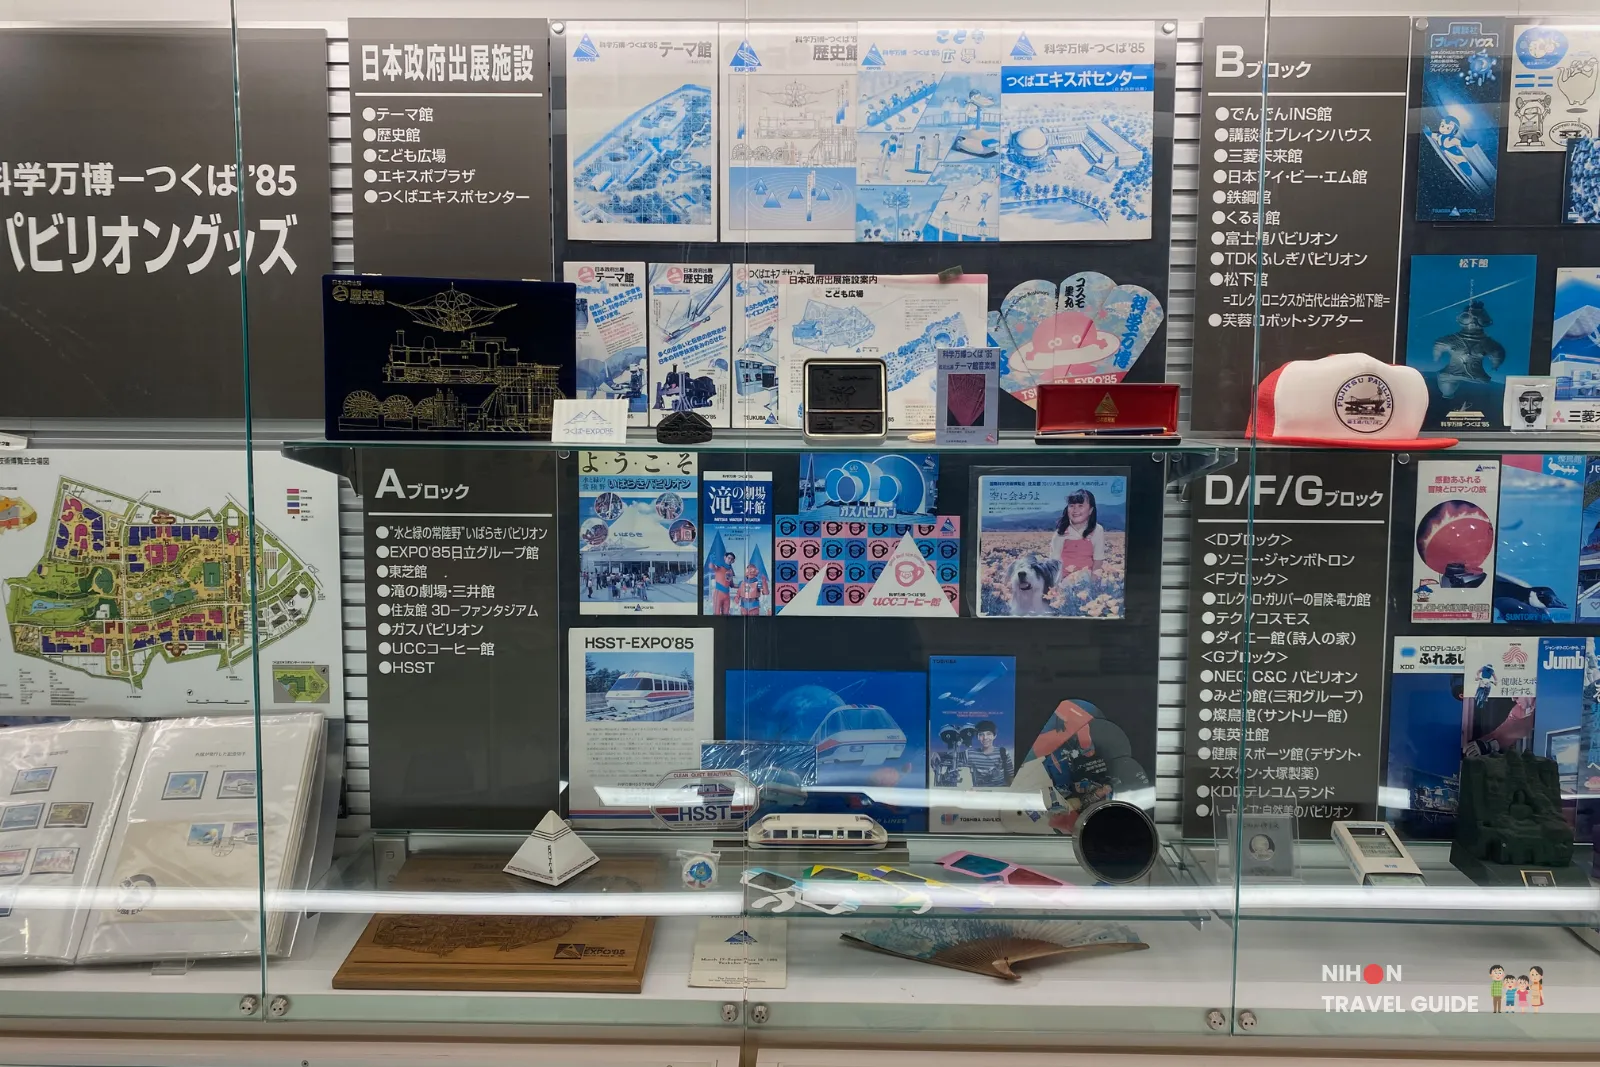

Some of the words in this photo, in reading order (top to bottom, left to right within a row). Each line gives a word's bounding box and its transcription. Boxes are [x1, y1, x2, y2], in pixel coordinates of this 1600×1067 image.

[659, 41, 712, 58] テーマ館
[361, 43, 534, 82] 日本政府出展施設
[1006, 70, 1147, 88] つくばエキスポセンター
[376, 107, 433, 123] テーマ館
[376, 127, 421, 143] 歴史館
[378, 148, 446, 164] こども広場
[378, 168, 475, 184] エキスポプラザ
[379, 189, 530, 204] つくばエキスポセンター
[6, 212, 297, 275] パビリオングッズ
[1225, 232, 1339, 246] 富士通パビリオン
[1225, 252, 1368, 266] TDKふしぎパビリオン
[1459, 258, 1489, 268] 松下館
[595, 273, 634, 283] テーマ館
[683, 274, 713, 284] 歴史館
[789, 275, 878, 285] 日本政府出展施設案内
[1224, 272, 1269, 287] 松下館
[825, 289, 864, 298] こども広場
[1075, 278, 1086, 309] コスモ
[1223, 293, 1391, 308] =エレクロニクスが古代と出会う松下館=
[1222, 313, 1364, 328] 芙蓉ロボット・シアター
[1113, 293, 1147, 369] 科学万博
[1337, 377, 1364, 408] FUJITSU
[1367, 376, 1392, 409] PAVILION
[375, 468, 470, 500] Aブロック
[608, 478, 691, 490] いばらきパビリオン
[1434, 476, 1481, 484] 感動あふれる
[989, 491, 1040, 501] 空に会おうよ
[1205, 475, 1384, 507] D/F/Gブロック
[840, 506, 897, 518] ガスパビリオン
[390, 546, 539, 560] EXPO'85日立グループ館
[1218, 553, 1355, 567] ソニー・ジャンボトロン
[389, 565, 427, 579] 東芝館
[391, 584, 495, 598] 滝の劇場・三井館
[1217, 593, 1371, 607] エレクロ・ガリバーの冒険・電力館
[391, 603, 428, 617] 住友館
[1505, 613, 1538, 621] SUNTORY
[392, 623, 484, 636] ガスパビリオン
[392, 642, 495, 656] UCCコーヒー館
[584, 637, 694, 650] HSST-EXPO'85
[1543, 651, 1584, 670] Jumb
[392, 662, 436, 674] HSST
[1214, 671, 1246, 683] NEC
[1252, 671, 1287, 683] C&C
[1292, 671, 1358, 684] パビリオン
[1212, 728, 1270, 742] 集英社館
[1212, 748, 1361, 762] 健康スポーツ館(デザント・
[1210, 786, 1335, 799] KDDテレコムランド
[679, 805, 731, 822] HSST
